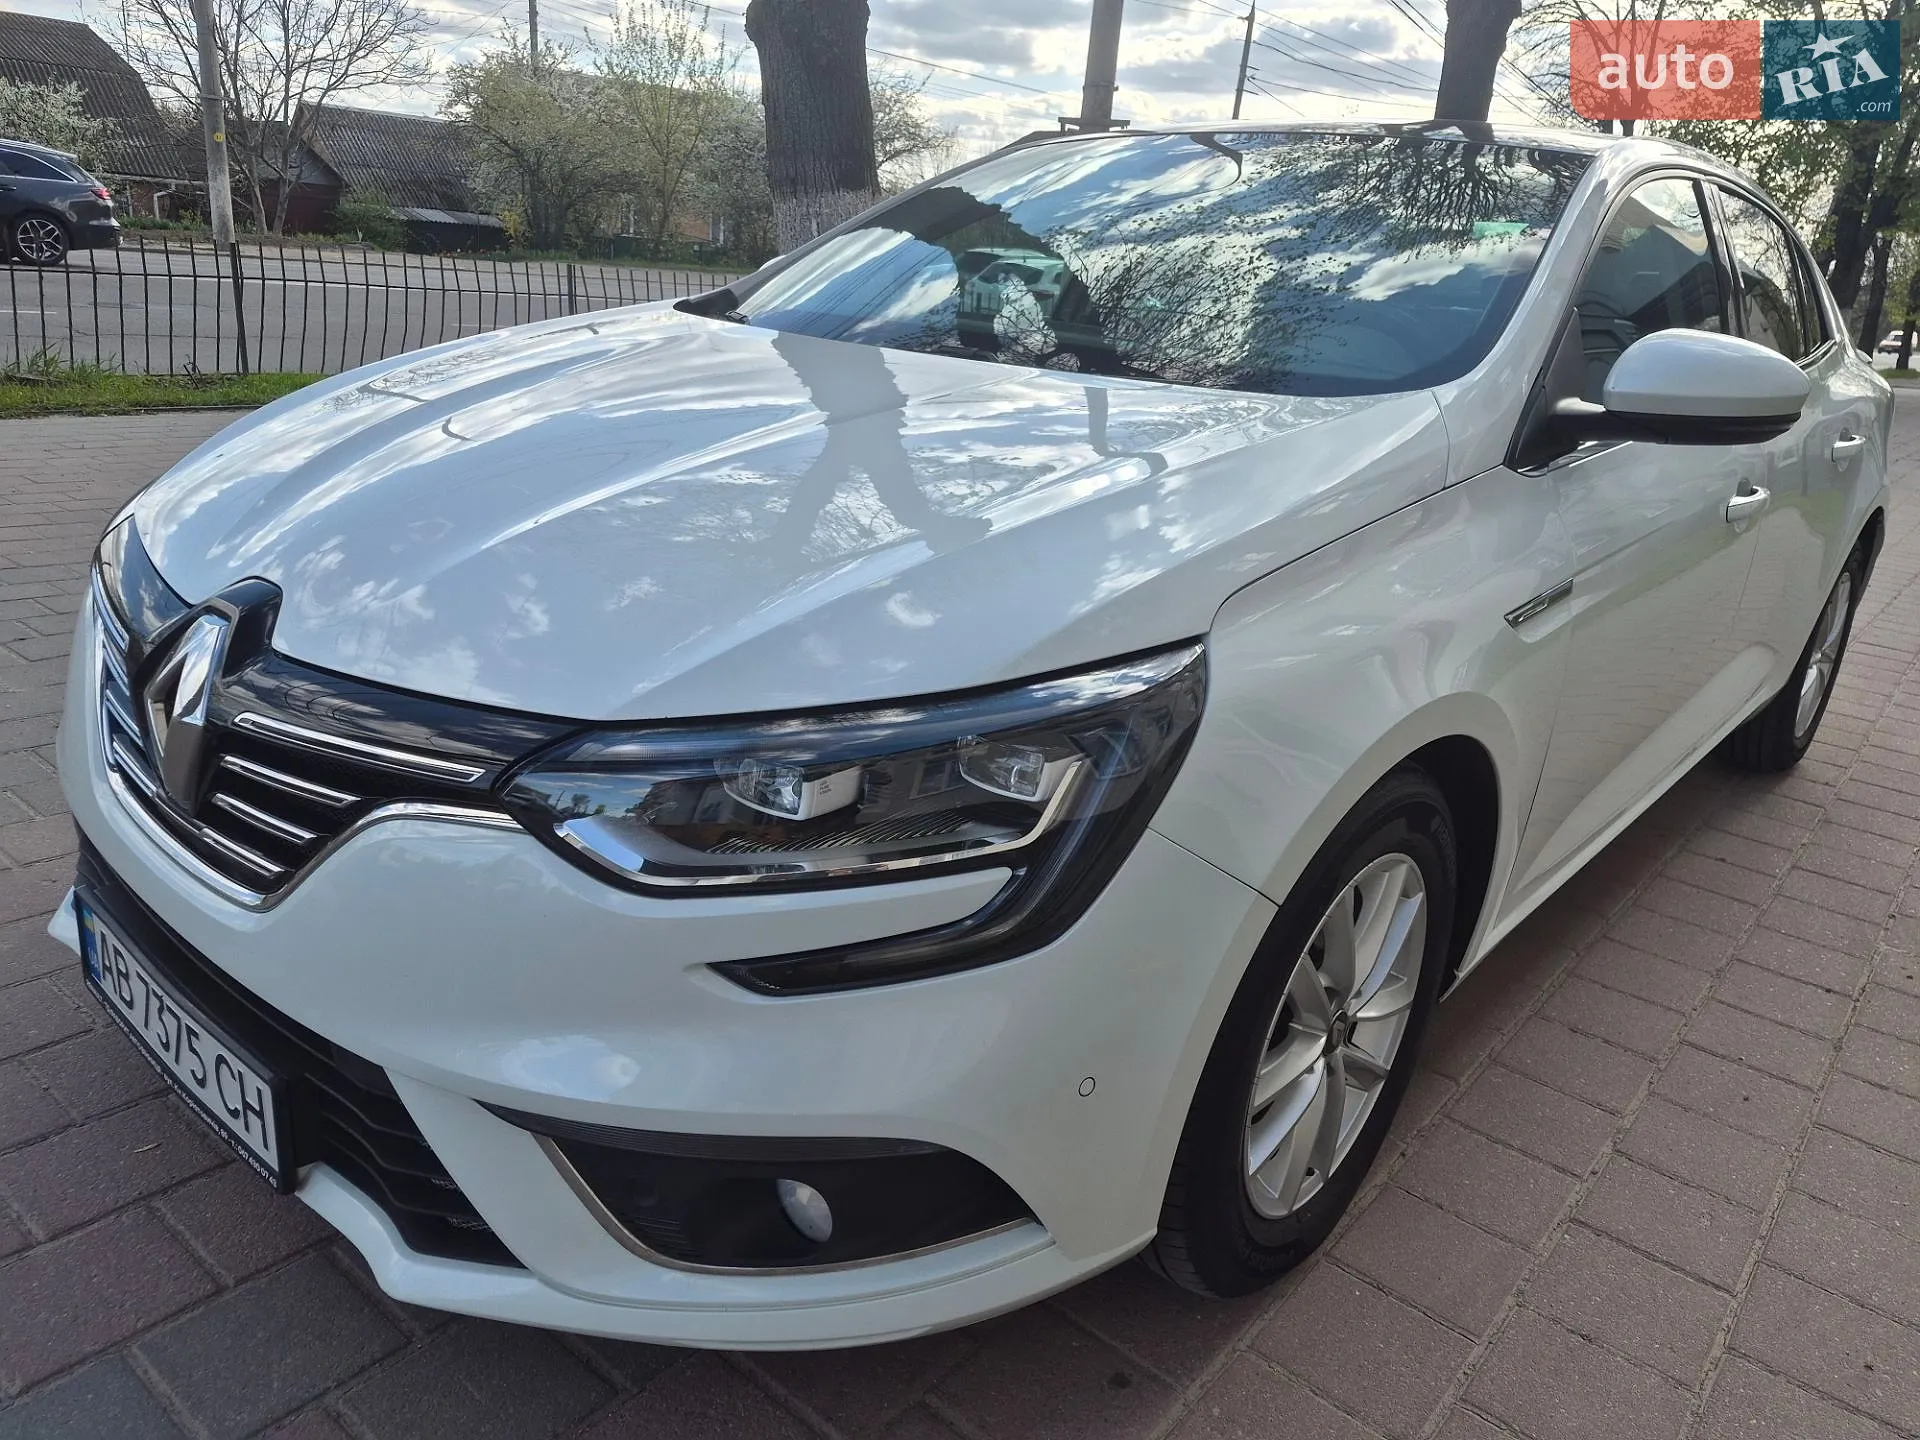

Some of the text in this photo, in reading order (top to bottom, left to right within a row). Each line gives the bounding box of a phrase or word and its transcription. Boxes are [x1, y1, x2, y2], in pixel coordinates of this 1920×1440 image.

[100, 930, 134, 1011] AB
[136, 970, 207, 1090] 7375
[214, 1052, 270, 1152] CH
